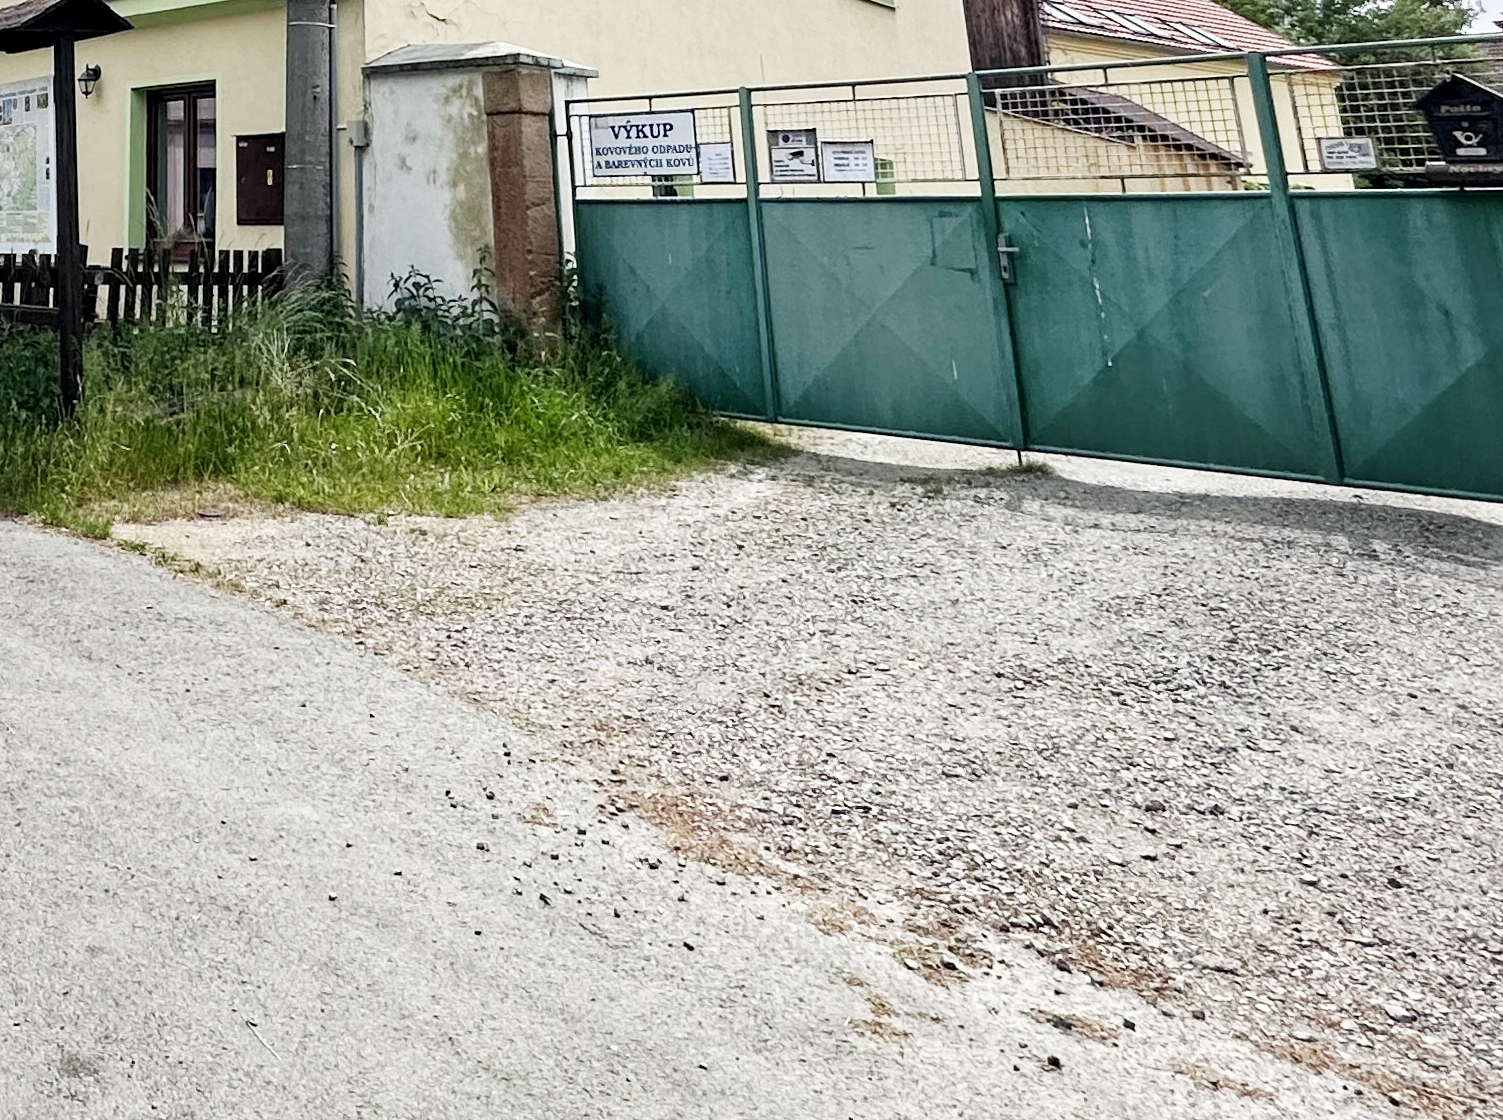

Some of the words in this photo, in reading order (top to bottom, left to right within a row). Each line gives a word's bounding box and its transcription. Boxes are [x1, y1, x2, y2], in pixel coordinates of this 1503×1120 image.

[609, 119, 674, 140] VÝKUP
[594, 144, 649, 156] KOVOVÉHO
[595, 161, 603, 170] A
[604, 157, 663, 170] BAREVNÝCH
